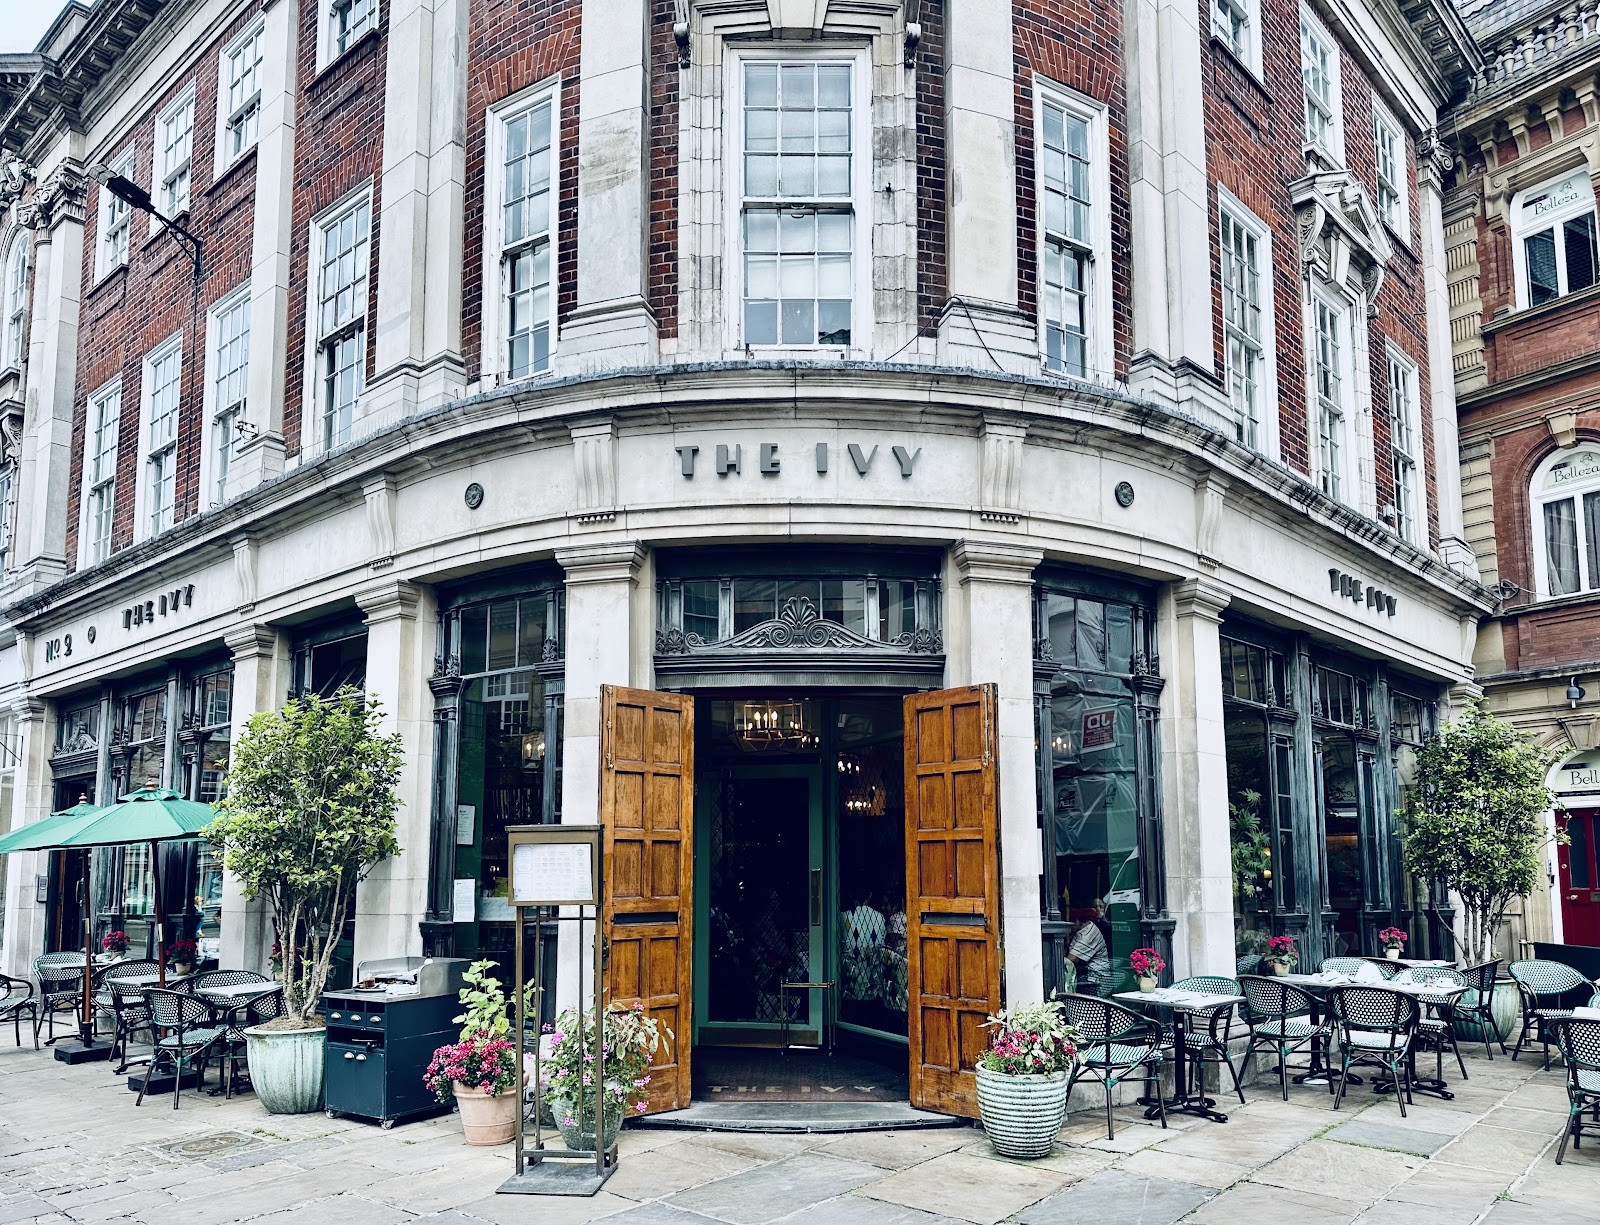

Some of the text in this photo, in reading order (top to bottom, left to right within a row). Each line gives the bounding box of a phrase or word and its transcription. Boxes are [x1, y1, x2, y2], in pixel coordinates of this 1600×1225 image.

[1534, 192, 1579, 215] Belleza
[675, 442, 923, 477] THE IVY
[1553, 465, 1600, 483] Belleza
[1328, 568, 1398, 617] THE IVY
[122, 584, 196, 630] THE IVY
[64, 633, 73, 657] 2
[708, 1085, 876, 1093] THE IVY
